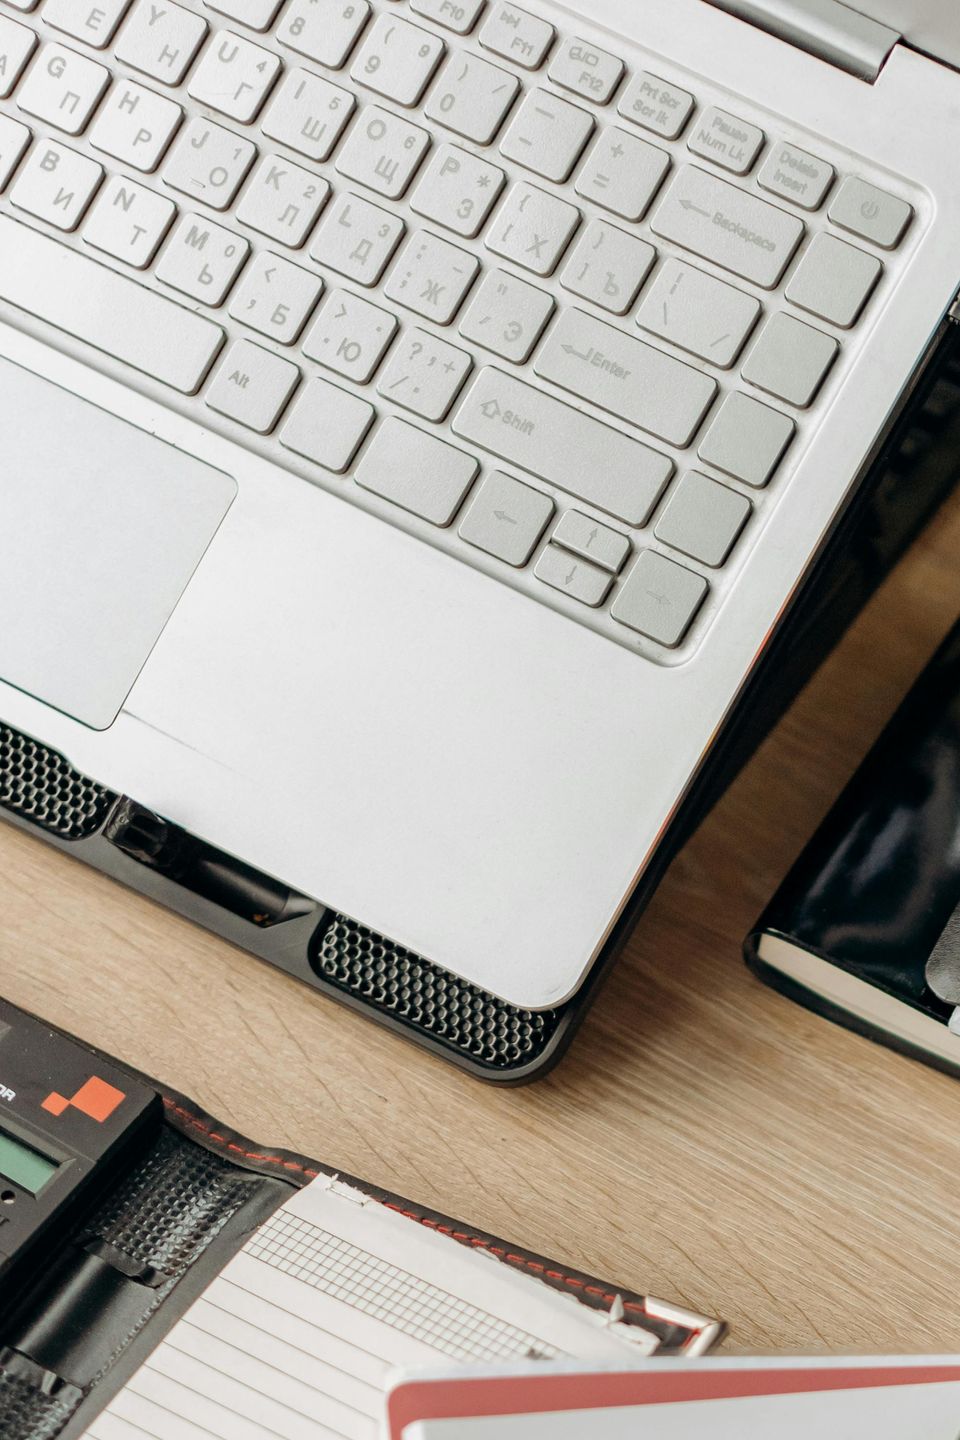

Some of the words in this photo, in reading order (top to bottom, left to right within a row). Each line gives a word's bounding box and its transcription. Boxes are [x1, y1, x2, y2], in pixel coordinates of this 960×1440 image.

[148, 5, 167, 26] Y
[343, 6, 356, 19] 8
[439, 1, 465, 21] F10
[289, 16, 306, 36] 8
[218, 41, 239, 64] U
[418, 44, 431, 58] 9
[510, 36, 535, 57] F11
[47, 56, 67, 79] G
[256, 61, 268, 73] 4
[364, 55, 381, 74] 9
[578, 71, 604, 92] F12
[118, 91, 140, 114] H
[329, 97, 342, 110] 5
[191, 131, 210, 149] J
[301, 116, 327, 142] Ш
[712, 116, 748, 142] Pause
[403, 135, 417, 149] 6
[697, 129, 726, 153] Num
[40, 149, 60, 172] B
[233, 148, 242, 160] 1
[779, 151, 819, 179] Delete
[439, 156, 461, 177] P
[265, 166, 288, 190] K
[52, 187, 75, 211] И
[113, 187, 136, 212] N
[303, 185, 317, 199] 2
[338, 204, 352, 228] L
[184, 225, 211, 251] M
[378, 223, 391, 238] 3
[711, 212, 777, 252] Backspace
[419, 279, 446, 306] Ж
[590, 353, 632, 380] Enter
[228, 370, 251, 389] Alt
[502, 410, 535, 436] Shift
